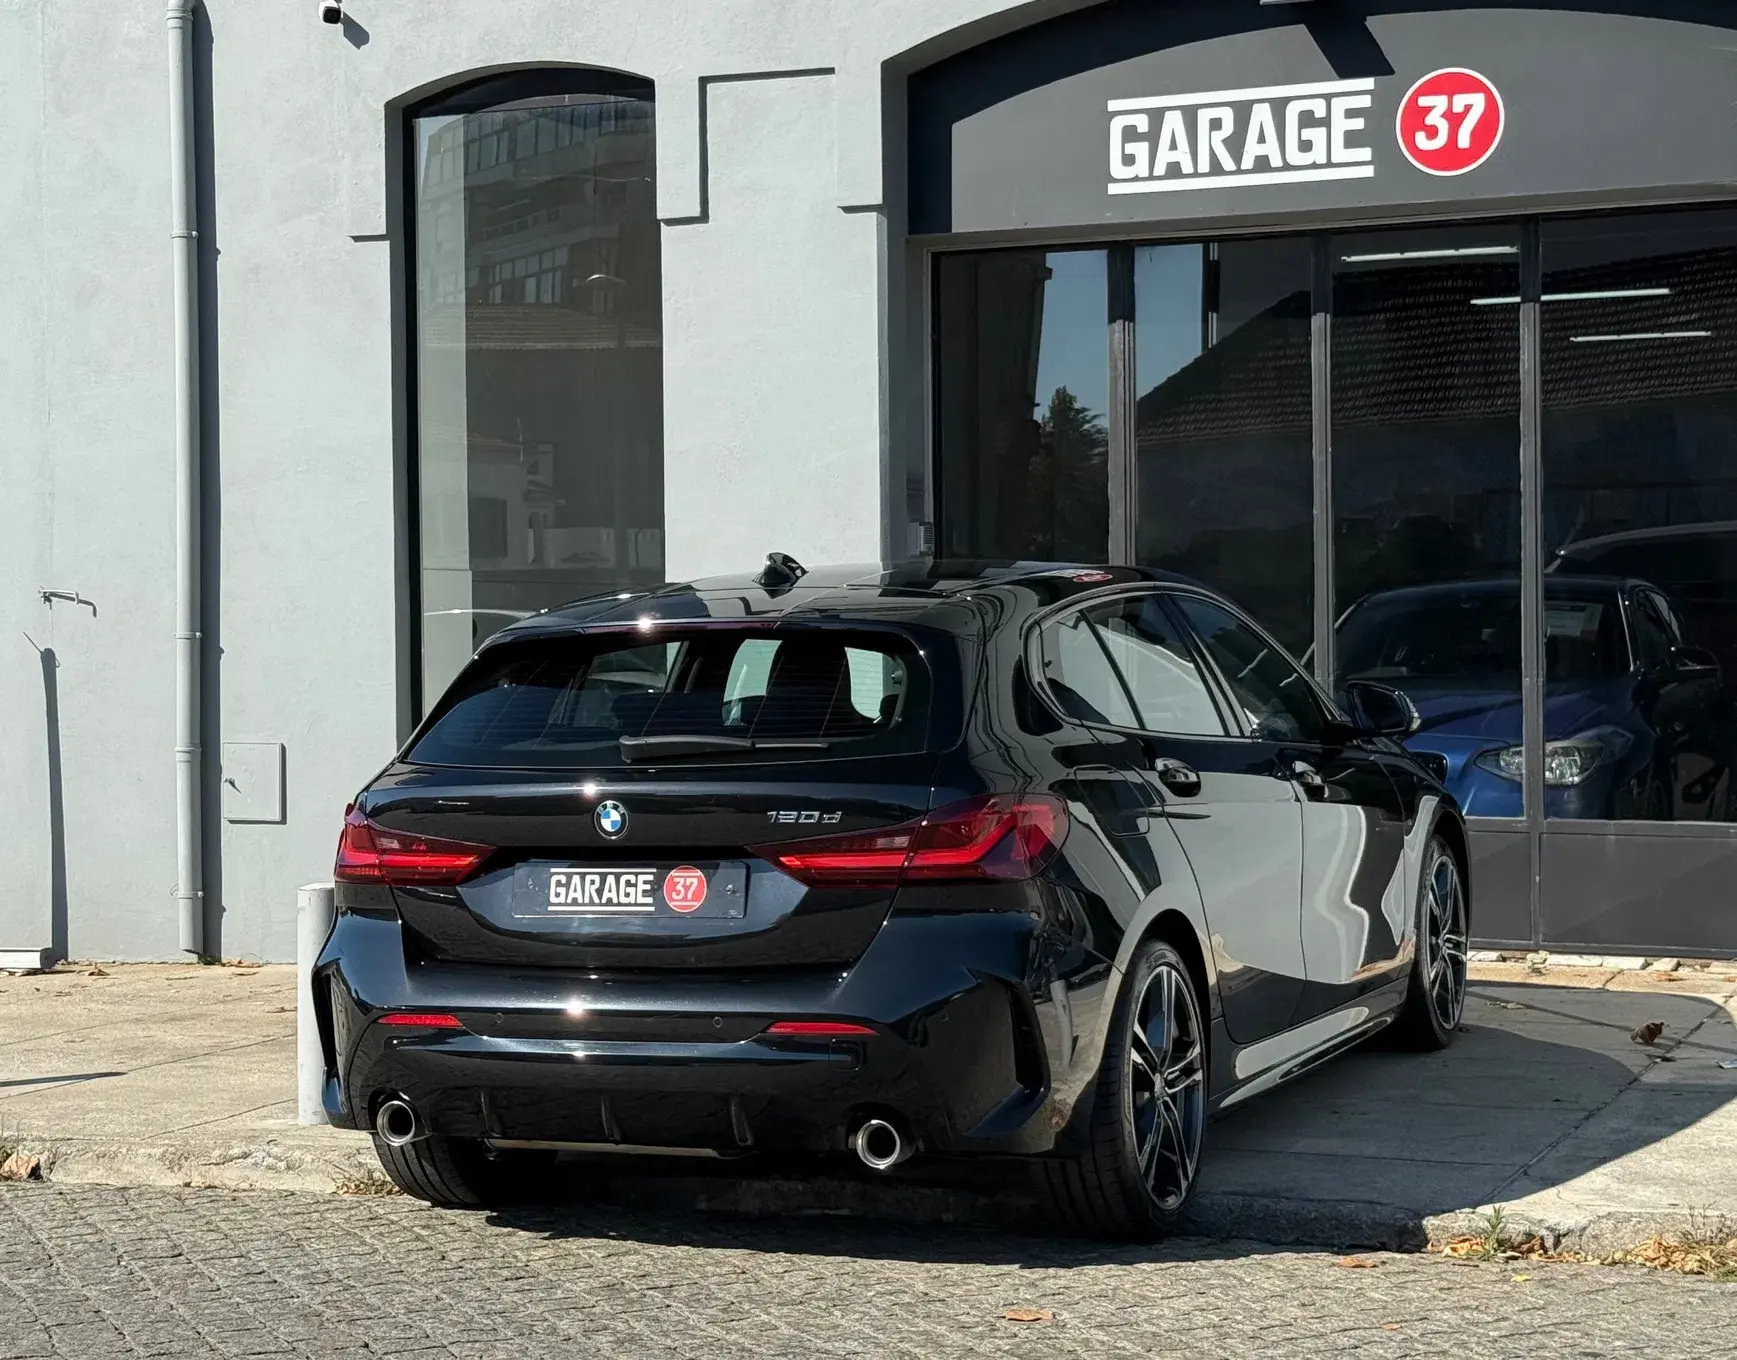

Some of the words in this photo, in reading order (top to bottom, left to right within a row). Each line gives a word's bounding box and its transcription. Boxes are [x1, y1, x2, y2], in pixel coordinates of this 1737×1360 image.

[1109, 94, 1372, 180] GARAGE
[1414, 92, 1487, 151] 37
[549, 874, 654, 904] GARAGE
[672, 877, 699, 900] 37
